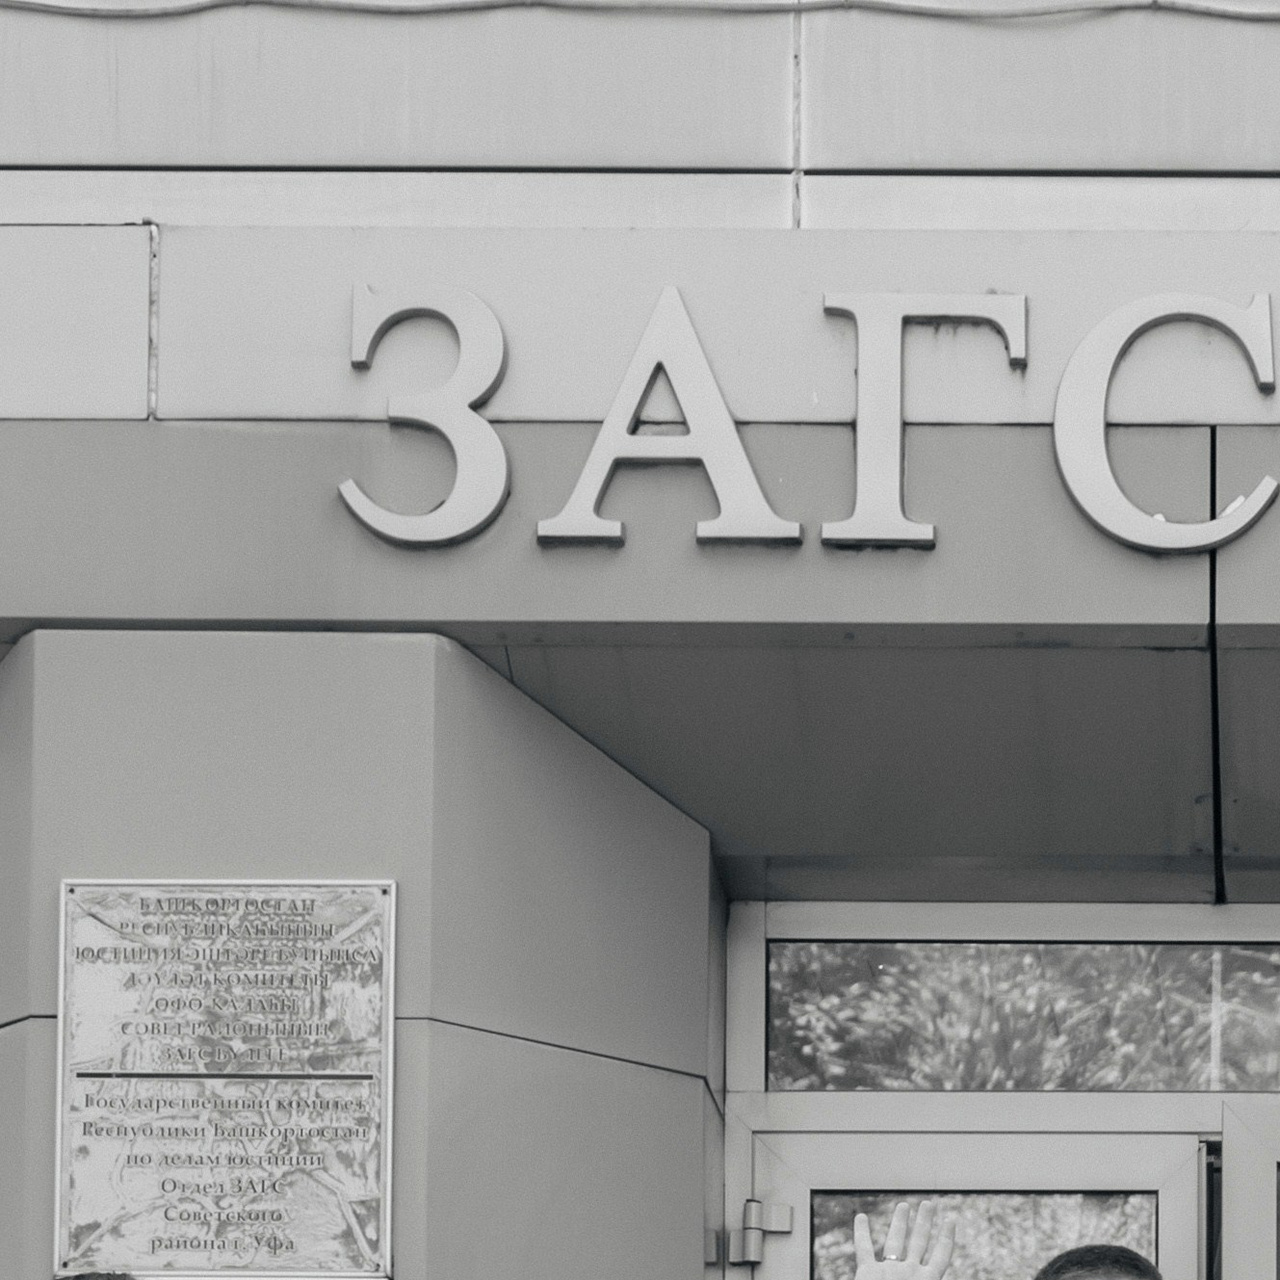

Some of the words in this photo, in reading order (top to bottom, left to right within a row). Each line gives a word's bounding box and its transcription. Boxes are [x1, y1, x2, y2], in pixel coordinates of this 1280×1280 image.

[338, 284, 1280, 554] ЗАГС
[82, 1122, 205, 1141] Республики
[126, 1154, 152, 1165] по
[159, 1154, 220, 1166] делам
[161, 1178, 224, 1194] Отдел
[232, 1178, 286, 1194] ЗАГС
[164, 1206, 283, 1221] Советского
[151, 1236, 226, 1254] района
